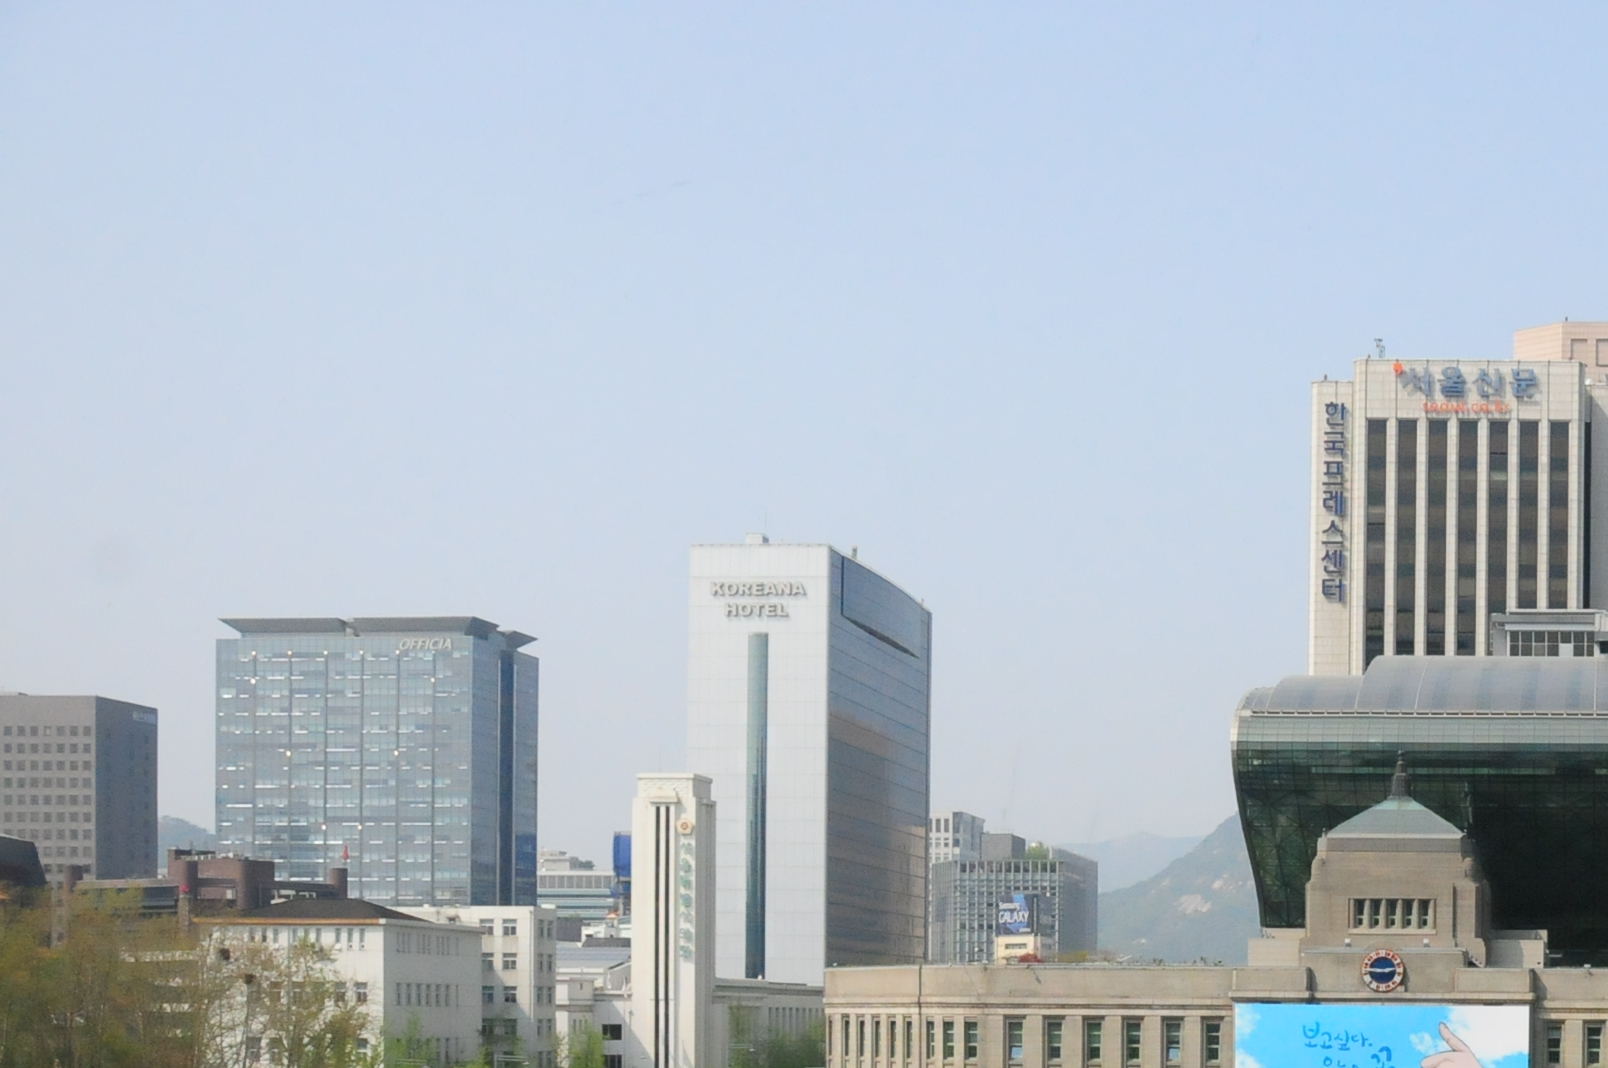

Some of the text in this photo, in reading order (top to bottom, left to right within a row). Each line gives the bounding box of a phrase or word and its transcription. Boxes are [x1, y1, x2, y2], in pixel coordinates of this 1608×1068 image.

[1401, 366, 1539, 398] 서울신문
[1321, 401, 1346, 602] 한국프레스센터
[710, 581, 807, 597] KOREANA
[725, 602, 789, 618] HOTEL
[399, 637, 452, 650] OFFICIA
